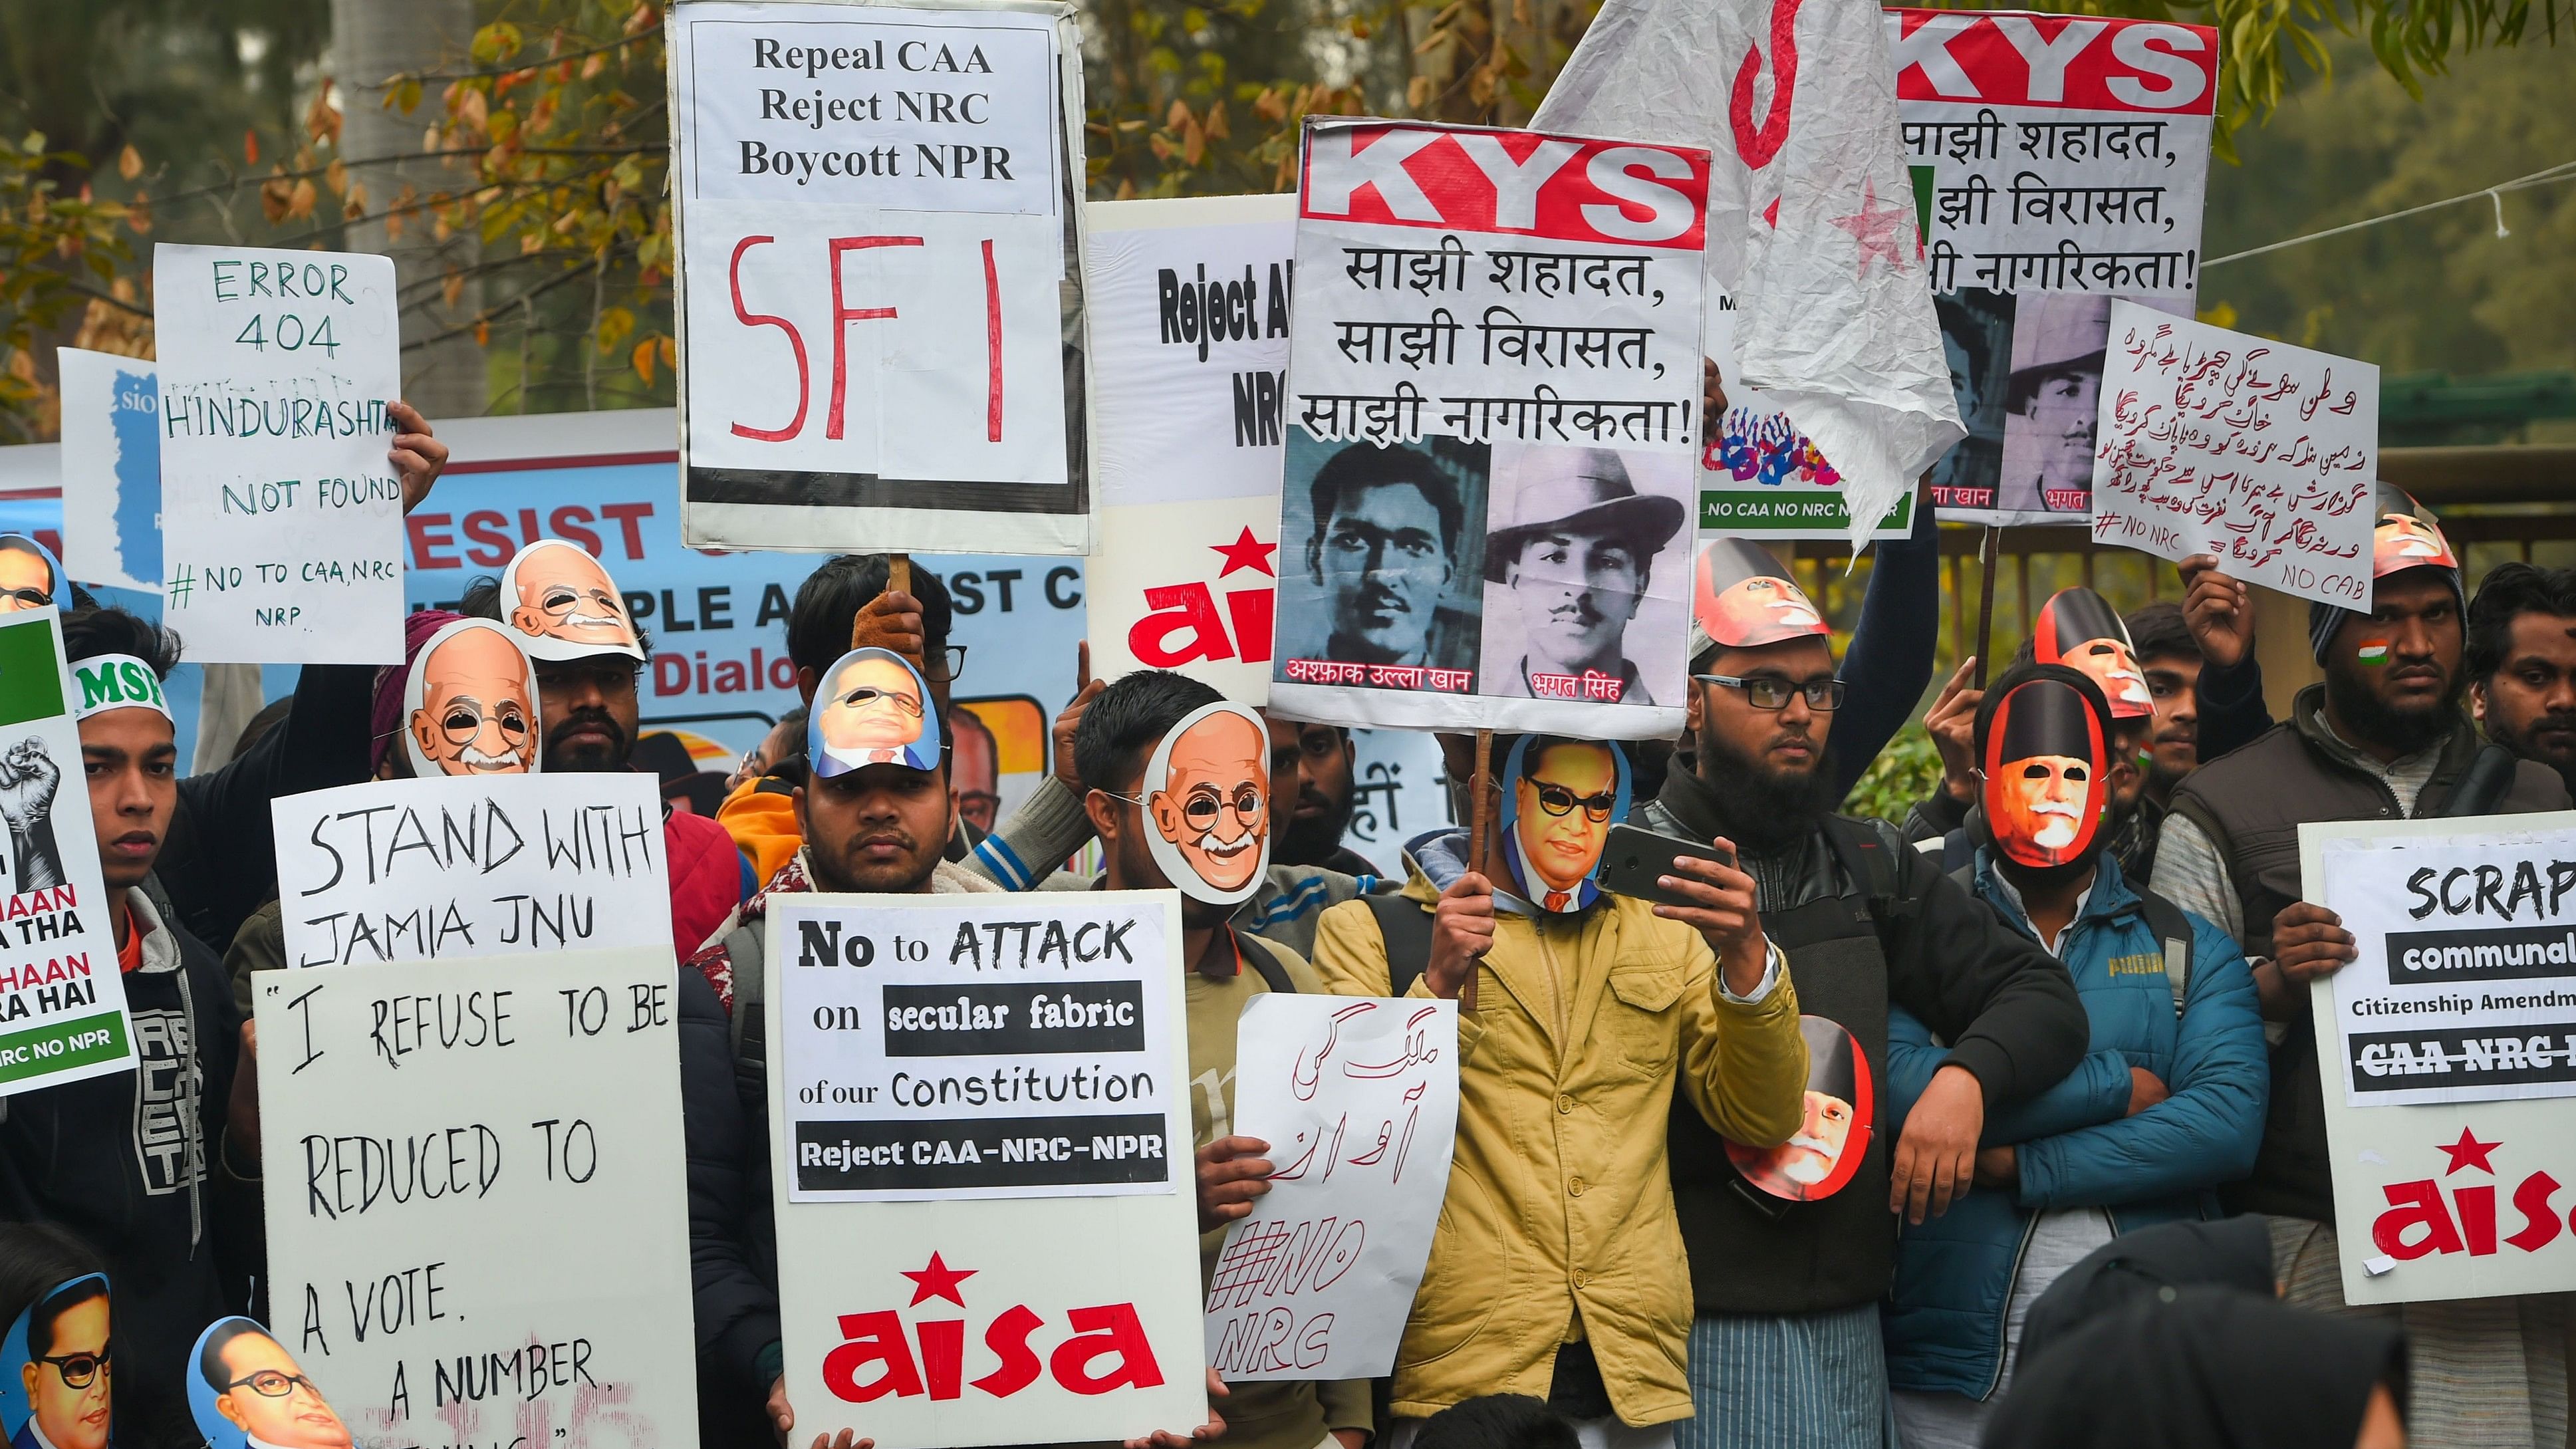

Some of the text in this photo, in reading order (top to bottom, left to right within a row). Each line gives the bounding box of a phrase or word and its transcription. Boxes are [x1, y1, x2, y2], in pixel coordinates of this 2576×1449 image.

[752, 37, 994, 80] Repeal CAA
[1884, 11, 2207, 108] KYS
[759, 88, 989, 129] Reject NRC
[738, 140, 1015, 185] Boycott NPR
[2016, 121, 2175, 168] शहादत,
[1307, 128, 1696, 241] KYS
[2007, 171, 2174, 233] विरासत,
[213, 260, 354, 305] ERROR
[1343, 234, 1664, 307] साझी शहादत,
[1973, 239, 2194, 291] नागरिकता!
[235, 313, 341, 359] 404
[729, 235, 1003, 442] SFI
[1158, 263, 1258, 362] Reject
[1333, 306, 1664, 379] साझी विरासत,
[1298, 381, 1691, 444] साझी नागरिकता!
[2300, 367, 2357, 422] وطن
[223, 473, 400, 517] NOT FOUND
[1708, 503, 1732, 517] NO
[1736, 503, 1769, 517] CAA
[1774, 503, 1797, 517] NO
[1802, 503, 1834, 517] NRC
[403, 502, 654, 571] ESIST
[2150, 525, 2180, 552] NRC
[255, 563, 288, 583] TO
[2281, 564, 2365, 600] NO CAB
[1128, 581, 1273, 668] ai
[653, 647, 798, 696] Dialo
[1430, 669, 1471, 691] खान
[1532, 673, 1577, 696] भगत
[1583, 670, 1623, 700] सिंह
[301, 797, 651, 898] STAND WITH
[2407, 859, 2576, 922] SCRAP
[15, 910, 84, 944] THA
[301, 894, 592, 968] JAMIA JNU
[798, 919, 1136, 972] No to ATTACK
[2402, 932, 2576, 972] communal
[37, 978, 96, 1014] HAI
[814, 993, 1134, 1032] on secular fabric
[2351, 994, 2474, 1017] Citizenship
[0, 1029, 111, 1067] RC NO NPR
[370, 991, 513, 1069] REFUSE
[561, 985, 607, 1038] TO
[627, 983, 668, 1033] BE
[799, 1065, 1154, 1109] of our Constitution
[301, 1119, 597, 1219] REDUCED TO
[801, 1133, 1164, 1172] Reject CAA-NRC-NPR
[2373, 1170, 2576, 1261] ais
[303, 1283, 329, 1355] A
[1214, 1307, 1334, 1374] NRC
[823, 1303, 1165, 1403] aisa
[392, 1361, 409, 1420] A
